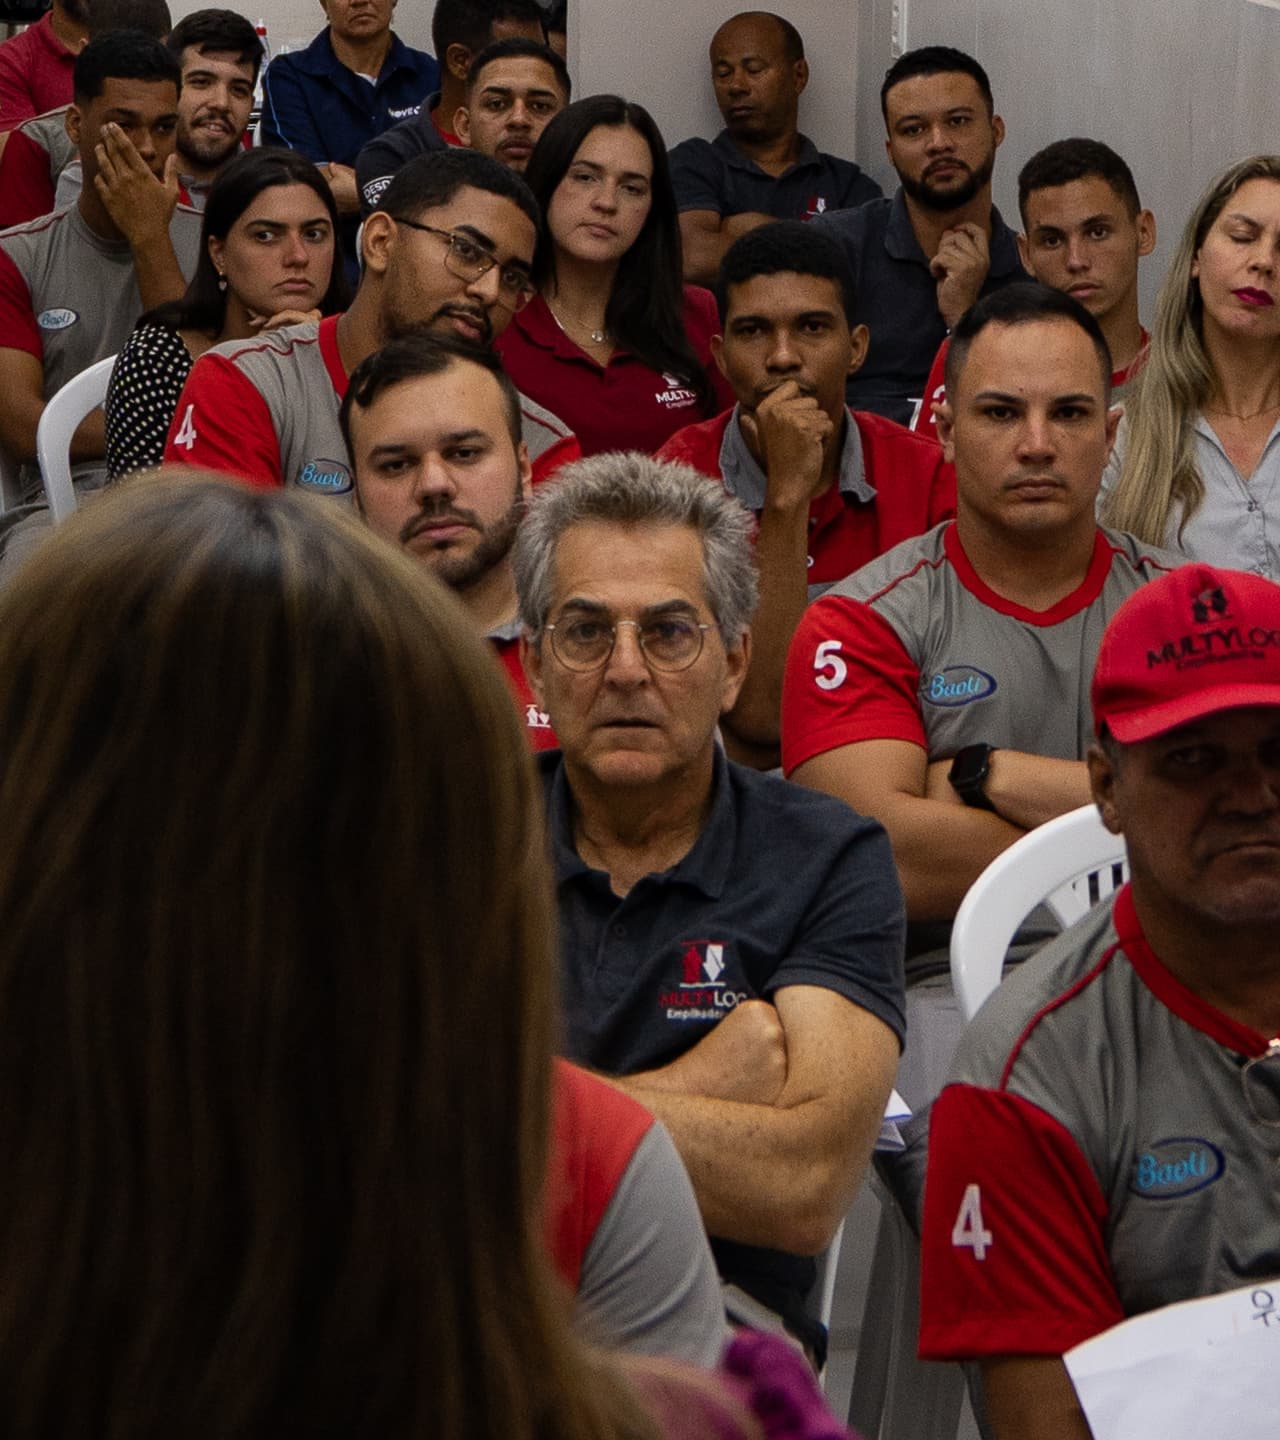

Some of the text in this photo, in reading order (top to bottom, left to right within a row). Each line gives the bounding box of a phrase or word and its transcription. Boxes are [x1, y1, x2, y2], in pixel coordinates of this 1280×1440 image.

[173, 403, 197, 451] 4
[813, 639, 848, 691] 5
[929, 674, 982, 699] Baoli
[1137, 1151, 1207, 1189] Baoli
[951, 1183, 994, 1261] 4
